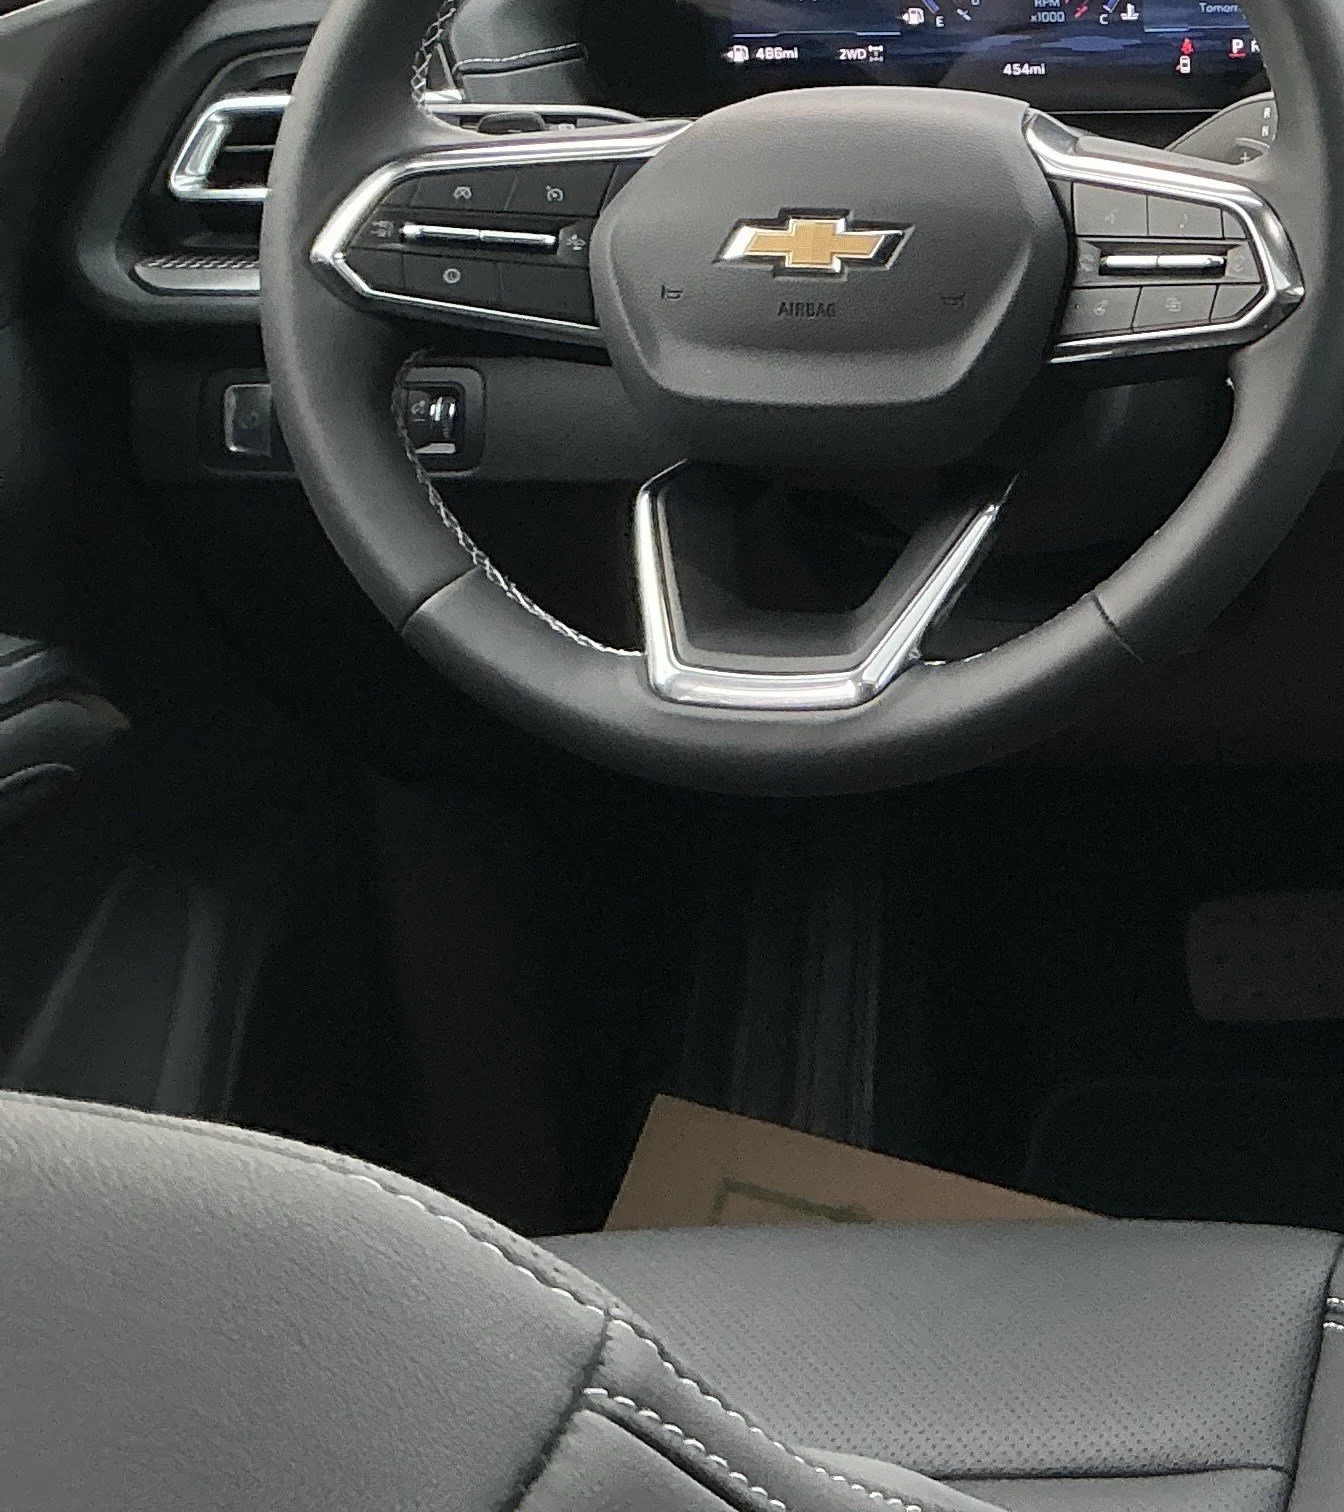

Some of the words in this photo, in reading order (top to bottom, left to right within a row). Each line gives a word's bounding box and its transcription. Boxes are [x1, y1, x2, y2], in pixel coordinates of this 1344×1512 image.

[936, 17, 945, 28] E
[1030, 11, 1066, 23] x1000
[1100, 14, 1109, 24] C
[1232, 39, 1244, 54] P
[838, 48, 867, 60] 2WD
[1003, 63, 1046, 77] 454mi
[777, 301, 838, 318] AIRBAG
